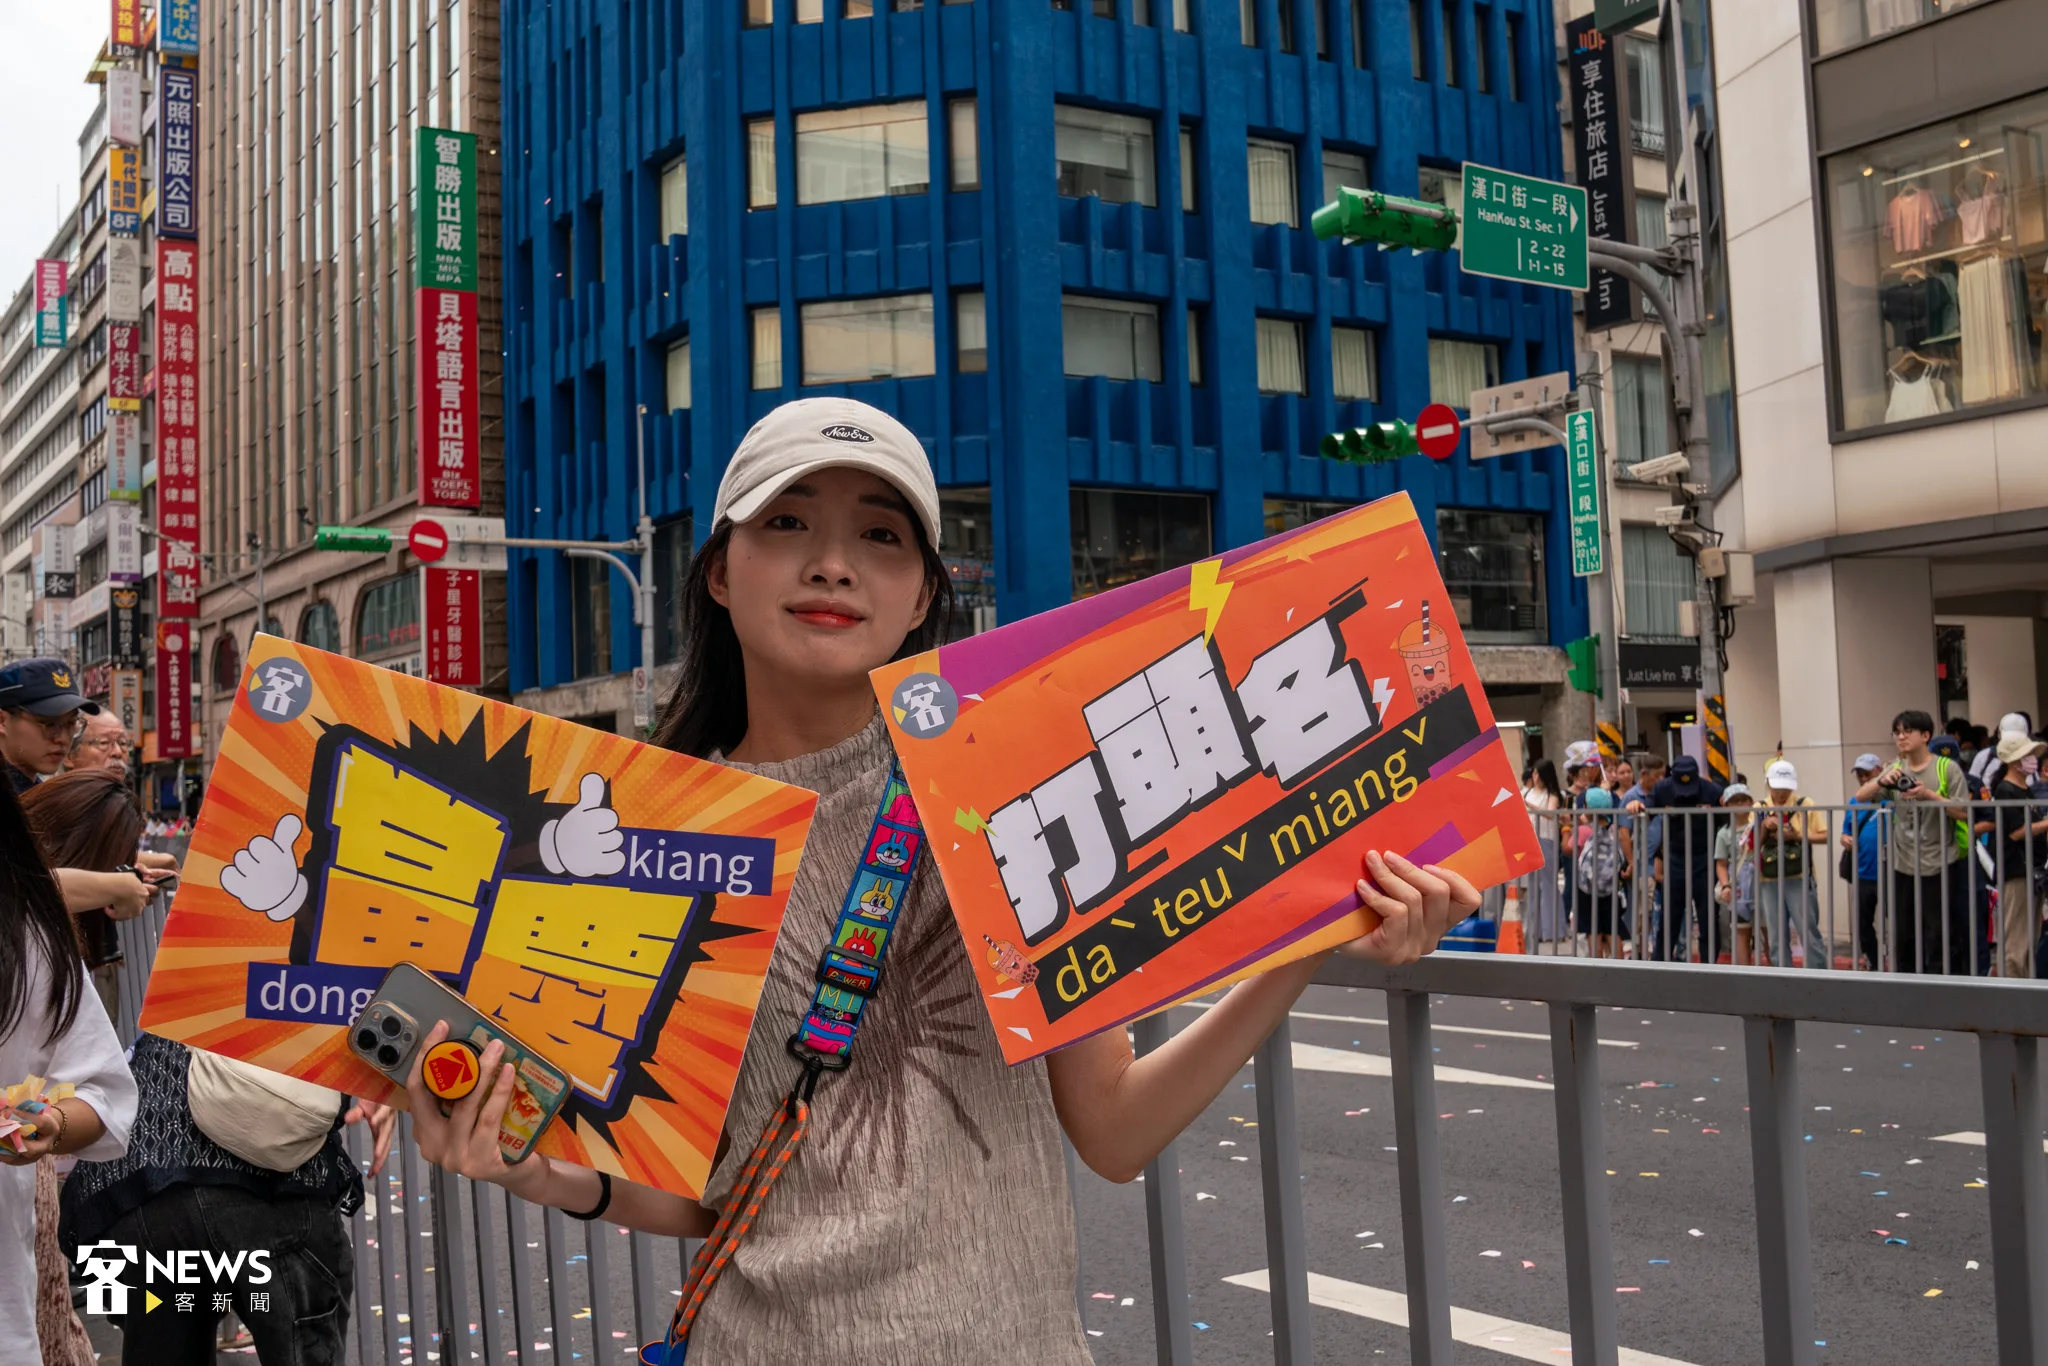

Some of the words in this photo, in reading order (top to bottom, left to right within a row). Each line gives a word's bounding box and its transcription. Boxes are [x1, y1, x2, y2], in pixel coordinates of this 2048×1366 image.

[1580, 58, 1609, 182] 享住旅店
[165, 74, 192, 229] 元照出版公司
[434, 134, 462, 252] 智勝出版
[1471, 174, 1568, 218] 漢口街一段
[1592, 189, 1609, 232] Just
[112, 212, 138, 230] 8F
[1477, 207, 1517, 227] HanKou
[1518, 216, 1532, 230] St.
[1535, 219, 1555, 234] Sec.
[1557, 223, 1563, 235] 1
[436, 253, 462, 265] MBA
[438, 263, 460, 275] MIS
[1529, 239, 1539, 254] 2
[1551, 244, 1566, 259] 22
[1552, 262, 1566, 277] 15
[163, 249, 194, 314] 高點
[436, 272, 462, 284] MPA
[1599, 277, 1615, 311] Inn
[111, 327, 133, 397] 留學家
[434, 292, 465, 469] 貝塔語言出版
[825, 426, 850, 437] New
[850, 429, 871, 441] Era
[432, 479, 472, 491] TOEFL
[1575, 425, 1592, 513] 漢口街一段
[433, 489, 470, 501] TOEIC
[167, 540, 197, 605] 高點
[258, 664, 305, 717] 客
[1625, 667, 1644, 682] Just
[1644, 667, 1661, 682] Live
[1662, 668, 1677, 681] Inn
[900, 680, 945, 733] 客
[990, 616, 1373, 941] 打頭名
[629, 834, 754, 897] kiang
[259, 969, 378, 1024] dong
[431, 1060, 446, 1090] KODAK
